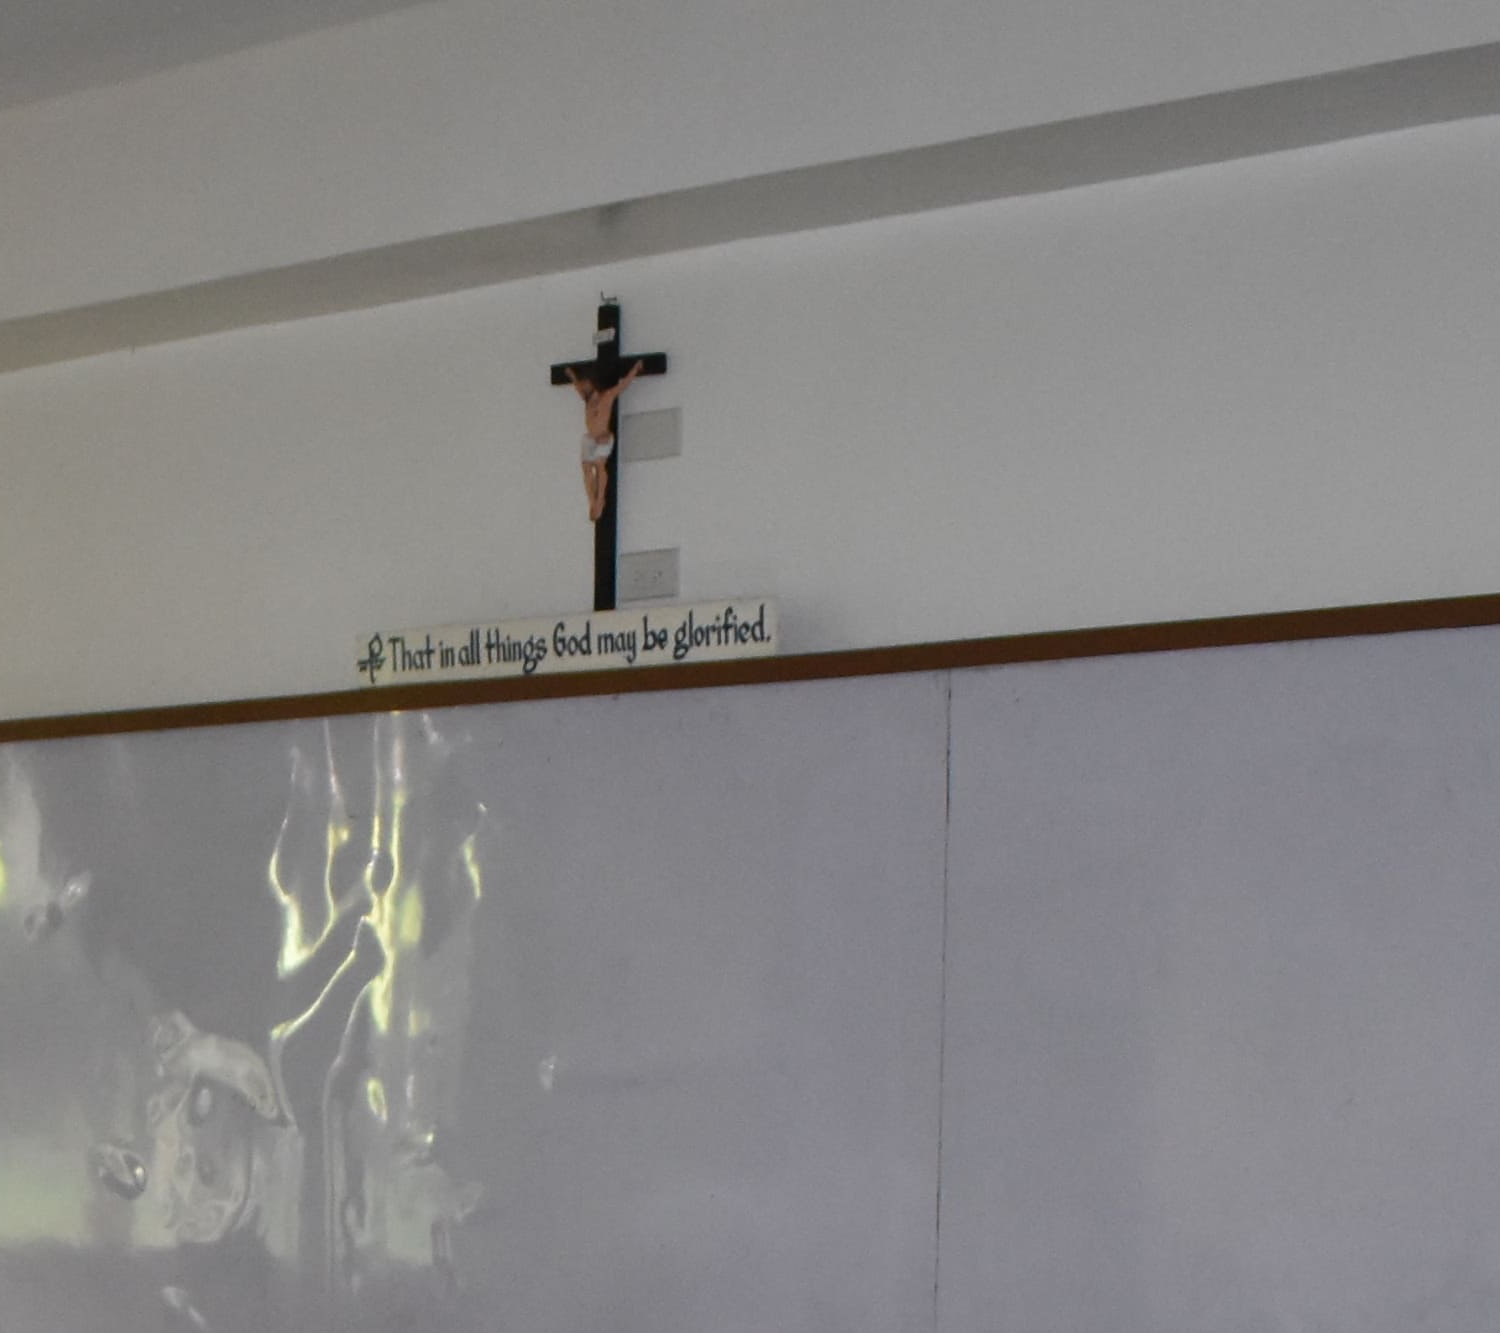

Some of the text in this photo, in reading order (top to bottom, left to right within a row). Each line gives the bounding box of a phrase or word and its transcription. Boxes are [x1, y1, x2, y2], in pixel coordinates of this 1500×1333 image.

[388, 603, 772, 674] That in all things God may be glorified.
